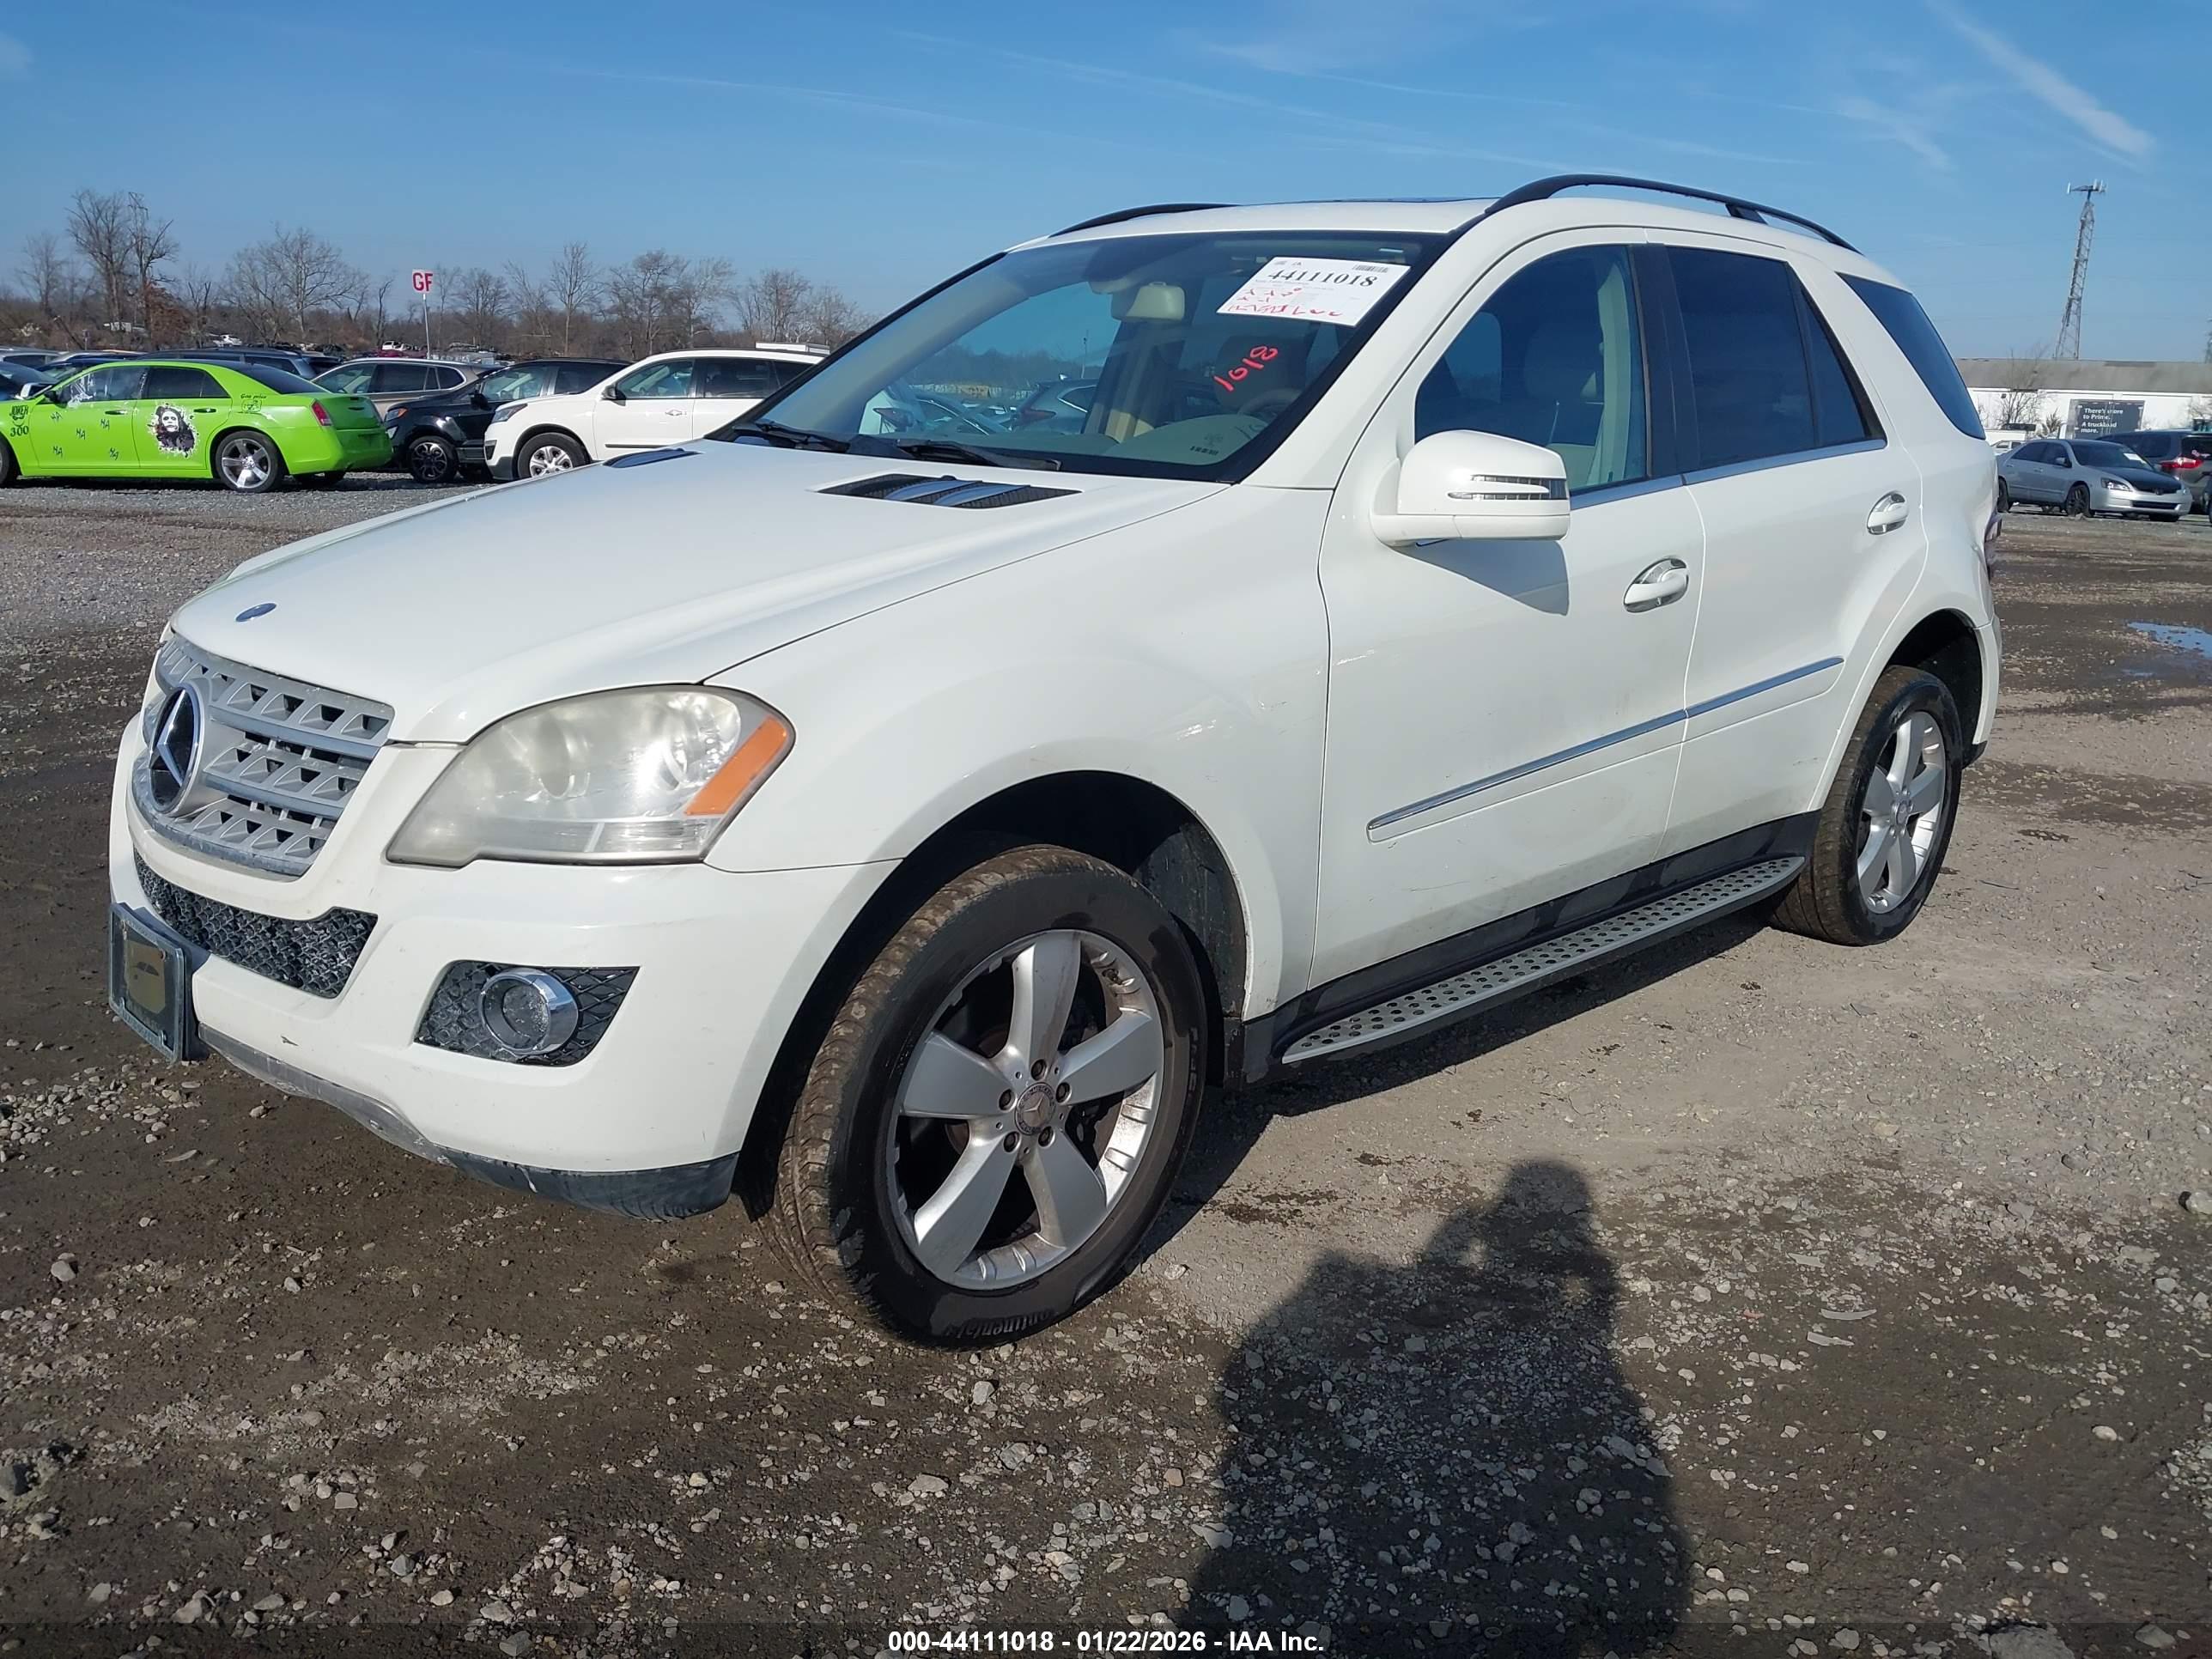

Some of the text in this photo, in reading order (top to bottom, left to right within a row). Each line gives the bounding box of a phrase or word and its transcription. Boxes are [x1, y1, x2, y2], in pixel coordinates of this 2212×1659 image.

[413, 272, 434, 292] GF
[1268, 270, 1377, 286] 44111018
[1213, 345, 1279, 392] 1018
[10, 426, 29, 437] 300
